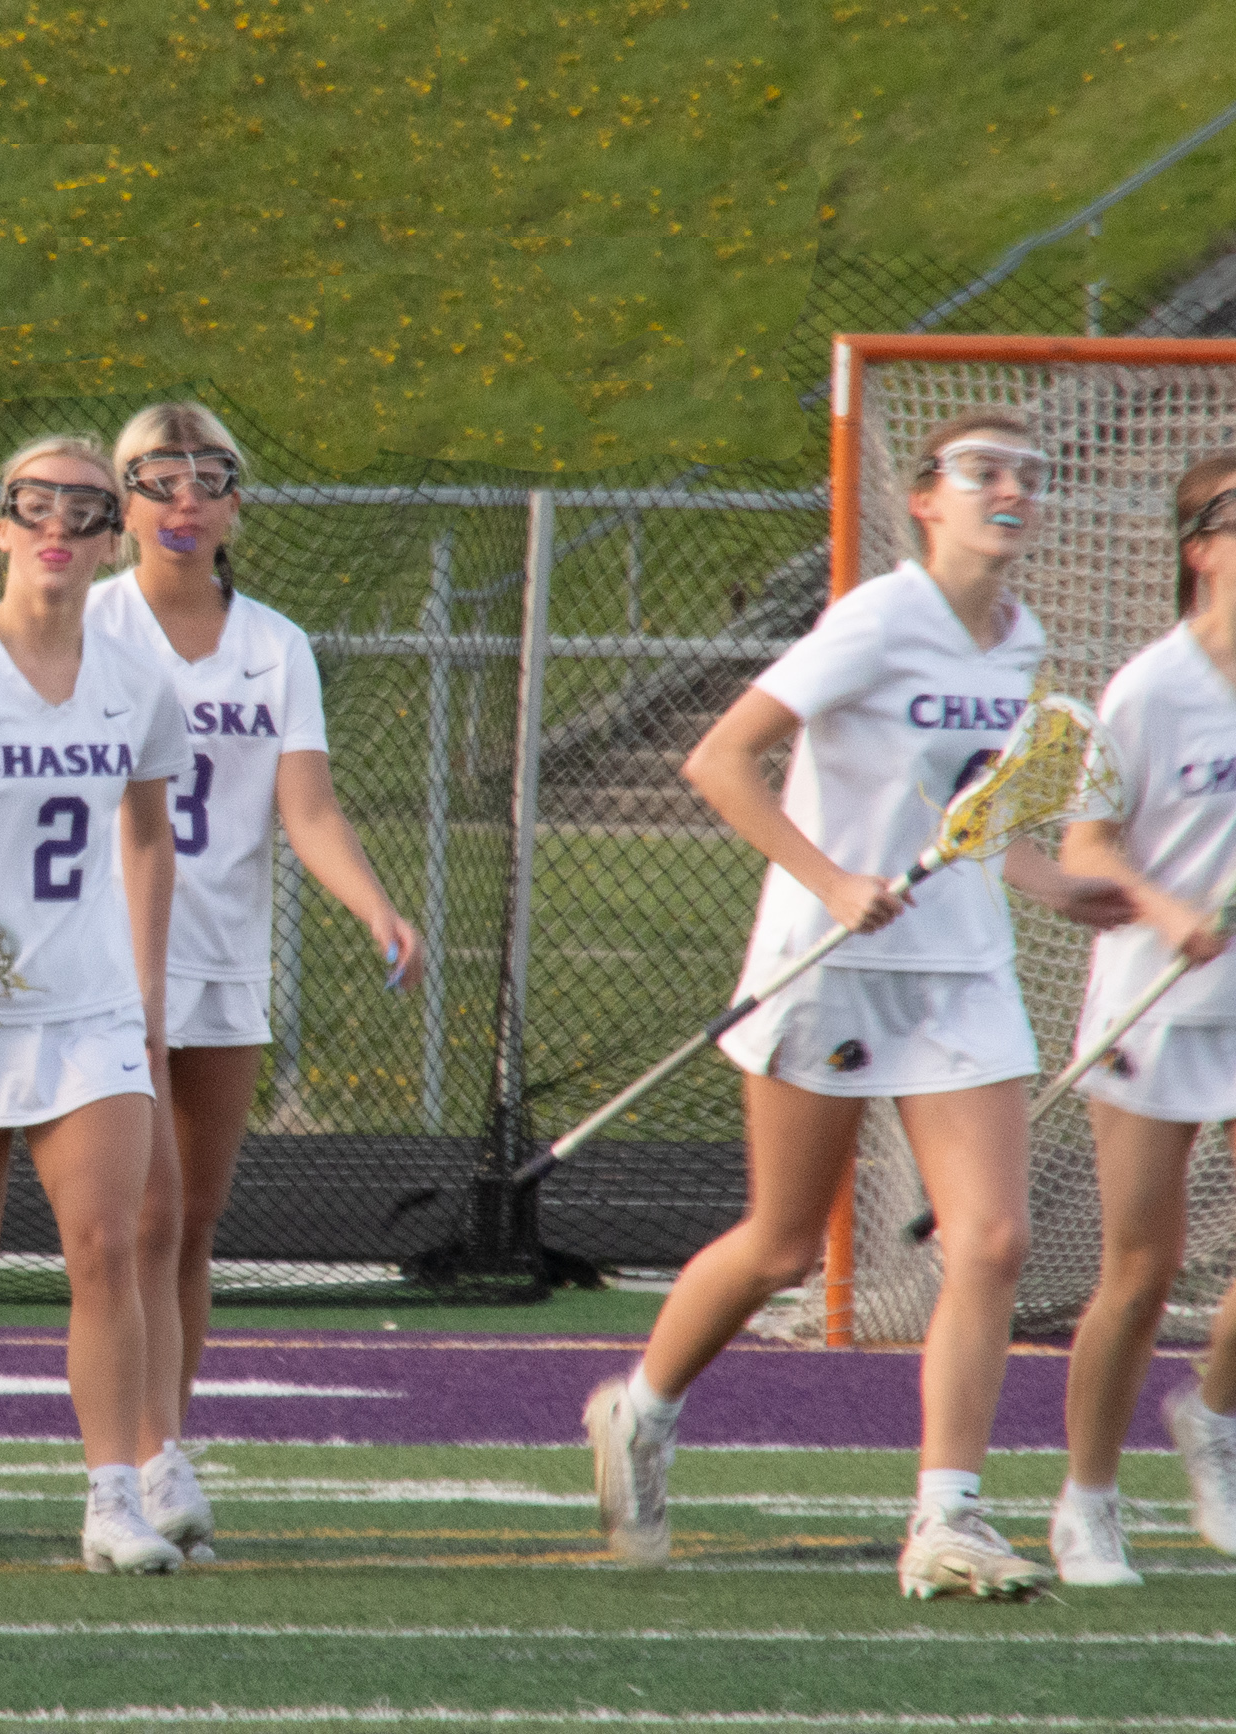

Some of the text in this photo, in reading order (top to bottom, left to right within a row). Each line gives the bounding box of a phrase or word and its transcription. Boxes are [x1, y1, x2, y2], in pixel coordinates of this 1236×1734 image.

[184, 702, 280, 738] SKA
[909, 693, 1029, 731] CHAS
[166, 753, 215, 858] 3
[33, 796, 90, 902] 2
